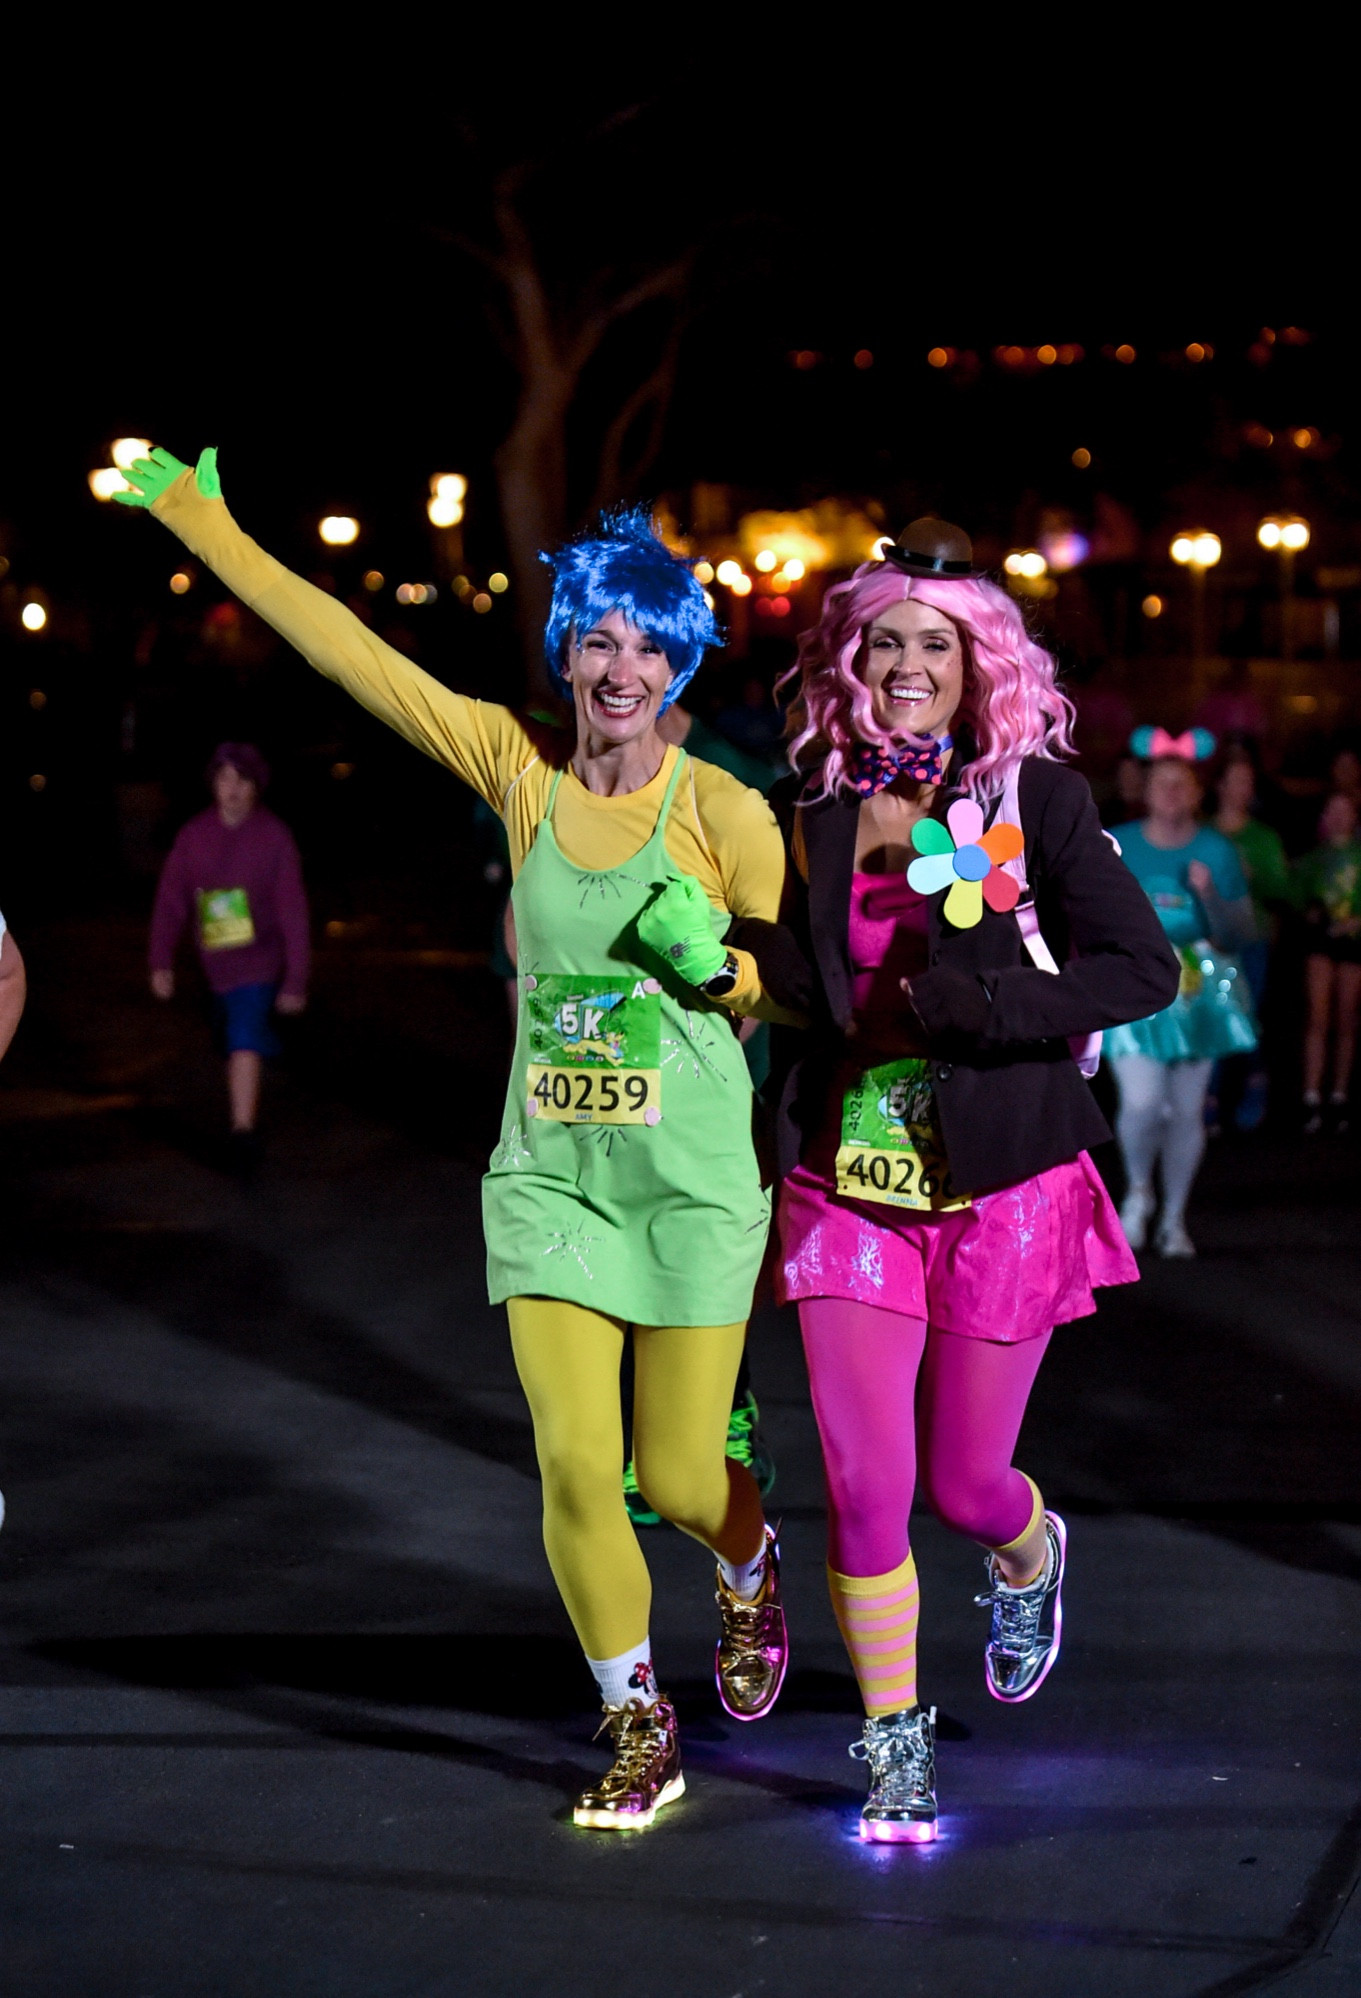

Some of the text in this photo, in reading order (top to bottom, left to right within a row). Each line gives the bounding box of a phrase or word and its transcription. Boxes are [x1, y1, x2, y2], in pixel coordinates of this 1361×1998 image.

[631, 981, 646, 999] A
[561, 1003, 604, 1040] 5K
[533, 1072, 649, 1112] 40259
[848, 1082, 864, 1131] 4026
